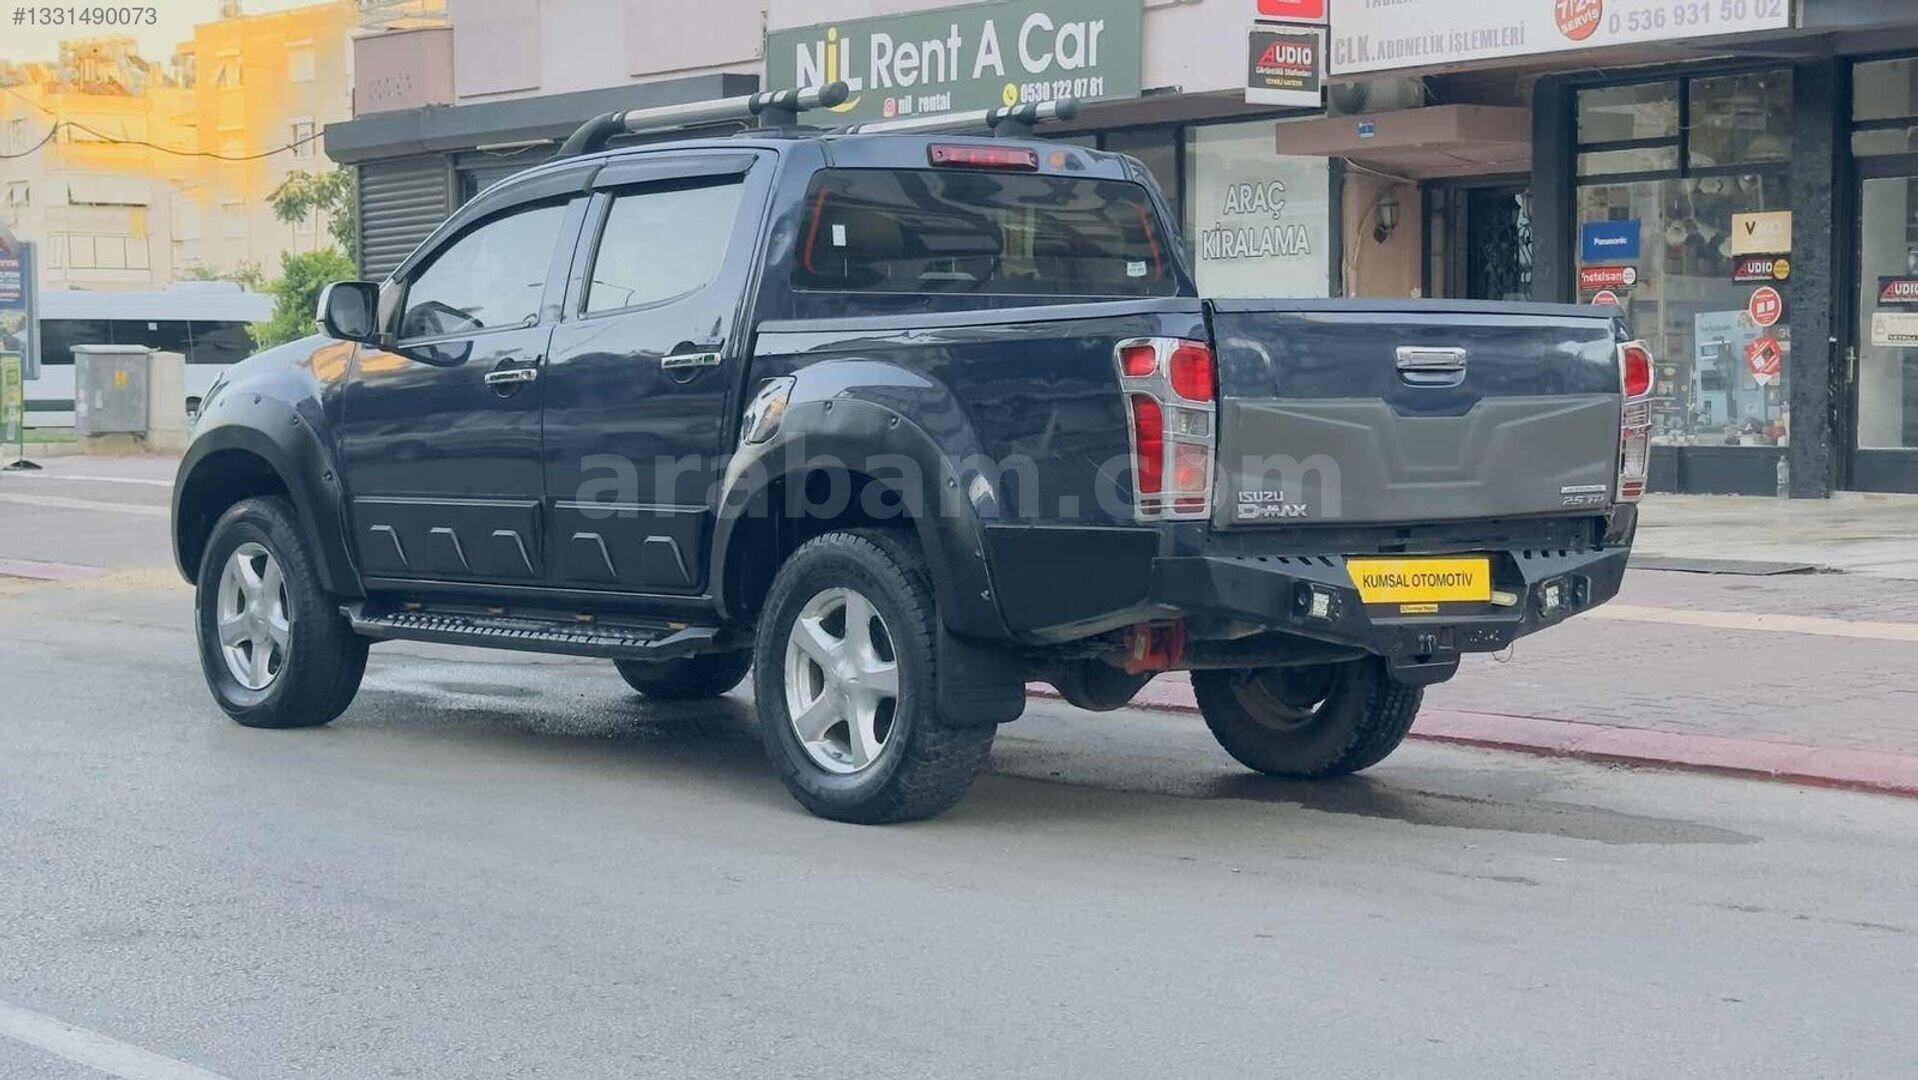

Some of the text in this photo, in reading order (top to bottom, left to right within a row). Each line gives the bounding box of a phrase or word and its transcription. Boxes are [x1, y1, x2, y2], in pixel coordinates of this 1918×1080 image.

[1608, 0, 1781, 34] 0 536 931 50 02
[870, 23, 962, 90] Rent
[972, 19, 1005, 79] A
[1018, 12, 1104, 74] Car
[1257, 41, 1313, 66] AUDIO
[1020, 77, 1104, 103] 0530 122 07 81
[1223, 180, 1286, 220] ARAÇ
[1202, 221, 1312, 261] KİRALAMA
[1735, 261, 1773, 277] AUDIO
[1238, 491, 1284, 503] ISUZU
[1238, 503, 1308, 519] D-MAX
[1363, 570, 1473, 588] KUMSAL OTOMOTİV
